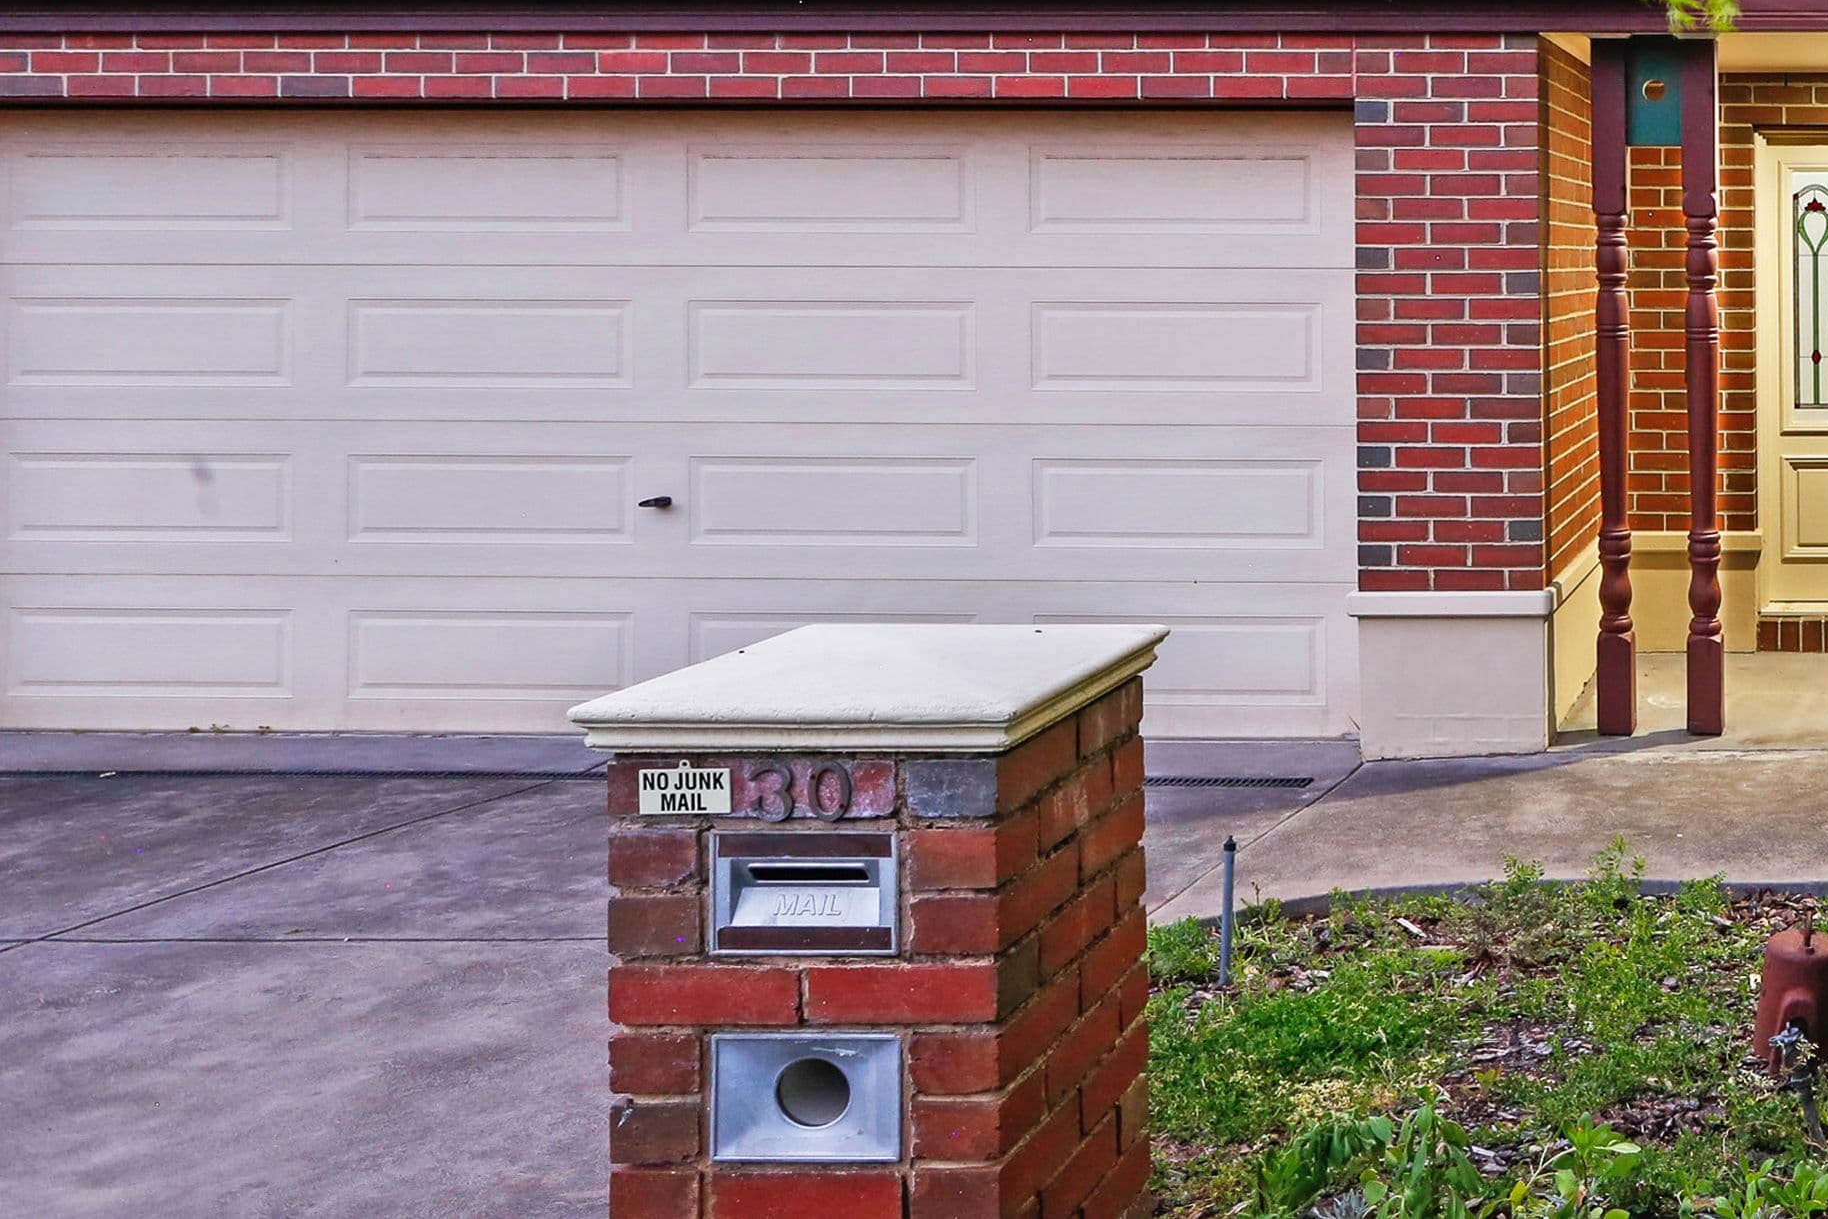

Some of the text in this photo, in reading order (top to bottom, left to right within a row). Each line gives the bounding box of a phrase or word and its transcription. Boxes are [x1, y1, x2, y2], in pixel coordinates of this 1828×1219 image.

[643, 772, 724, 790] NO JUNK
[748, 760, 852, 822] 30
[660, 793, 707, 812] MAIL
[773, 894, 842, 916] MAIL
